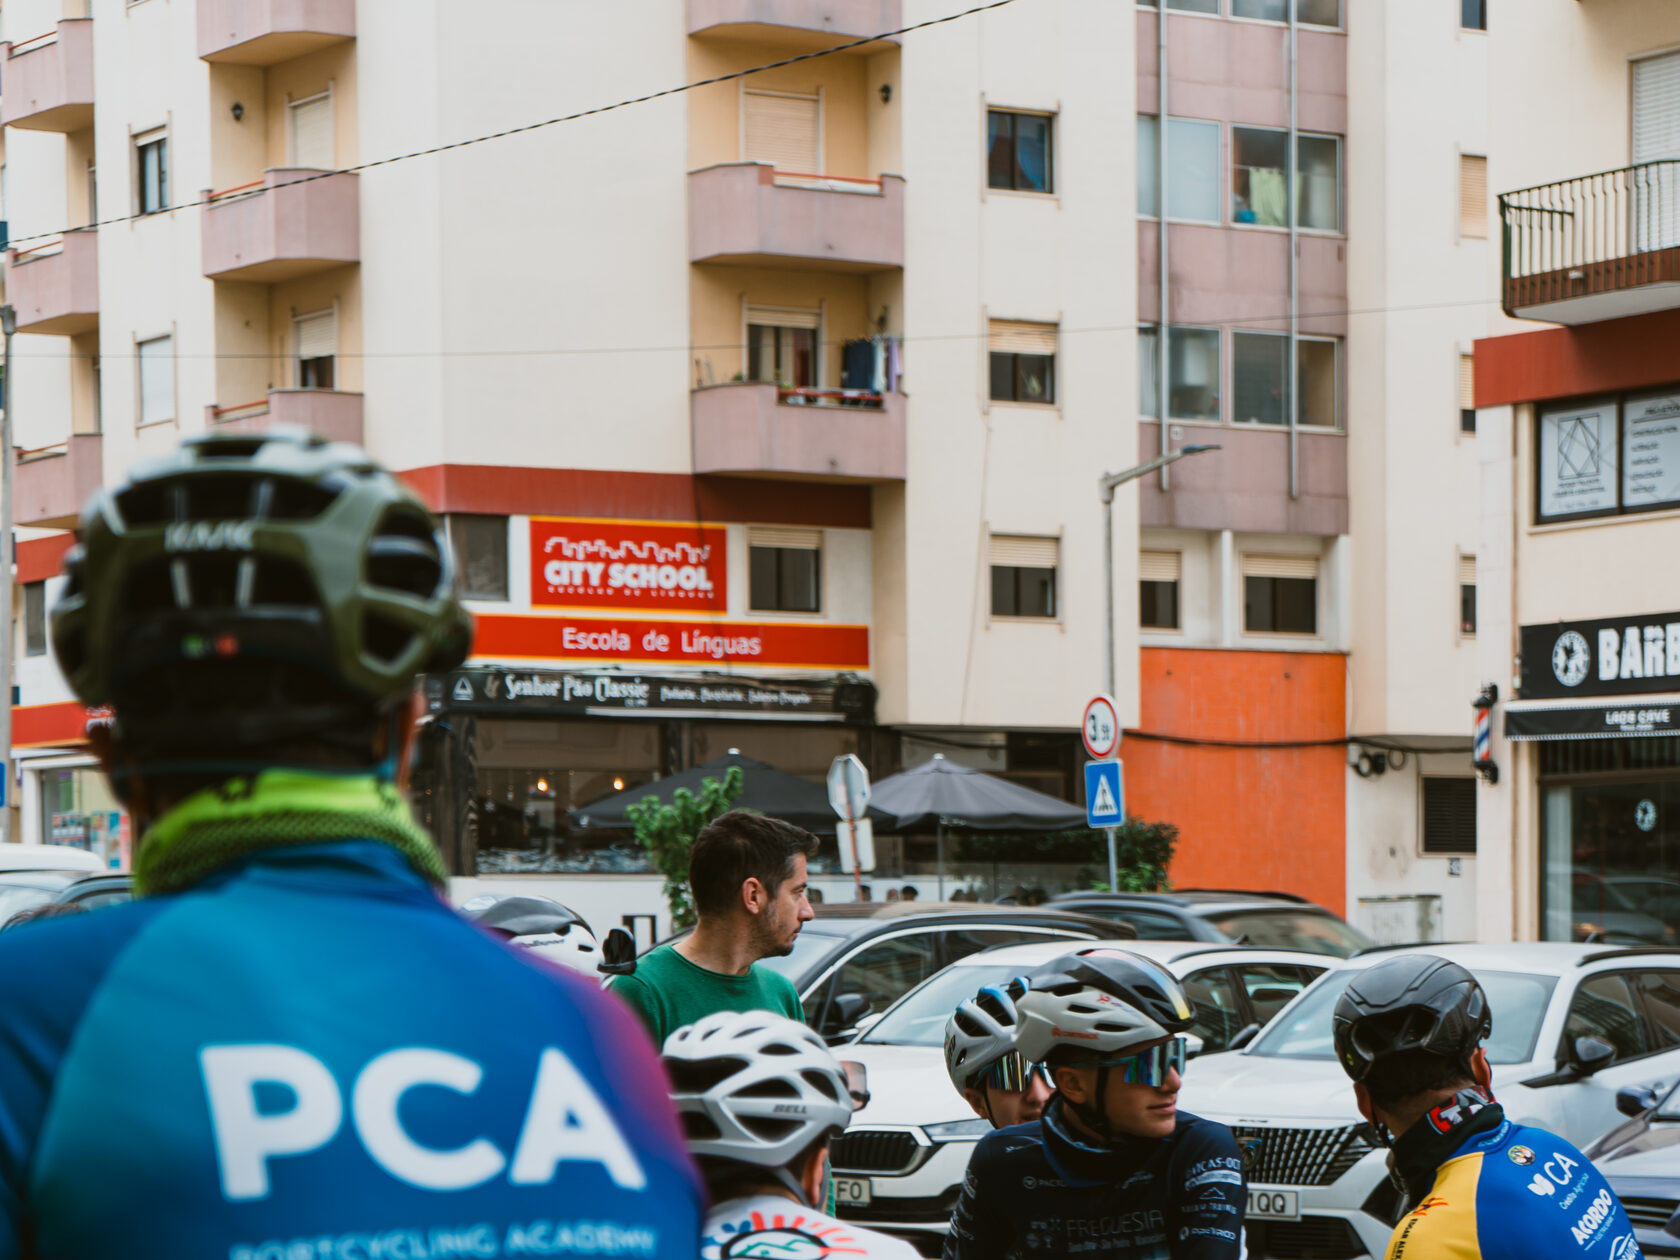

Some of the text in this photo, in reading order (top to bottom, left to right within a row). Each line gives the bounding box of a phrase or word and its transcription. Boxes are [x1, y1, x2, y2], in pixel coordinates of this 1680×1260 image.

[544, 560, 713, 590] CITY SCHOOL
[562, 627, 762, 658] Escola de Línguas
[505, 674, 650, 701] Senhor Pão Classic
[200, 1043, 648, 1201] PCA
[773, 1104, 807, 1115] BELL
[1544, 1152, 1579, 1185] CA
[505, 1221, 658, 1257] ACADEMY
